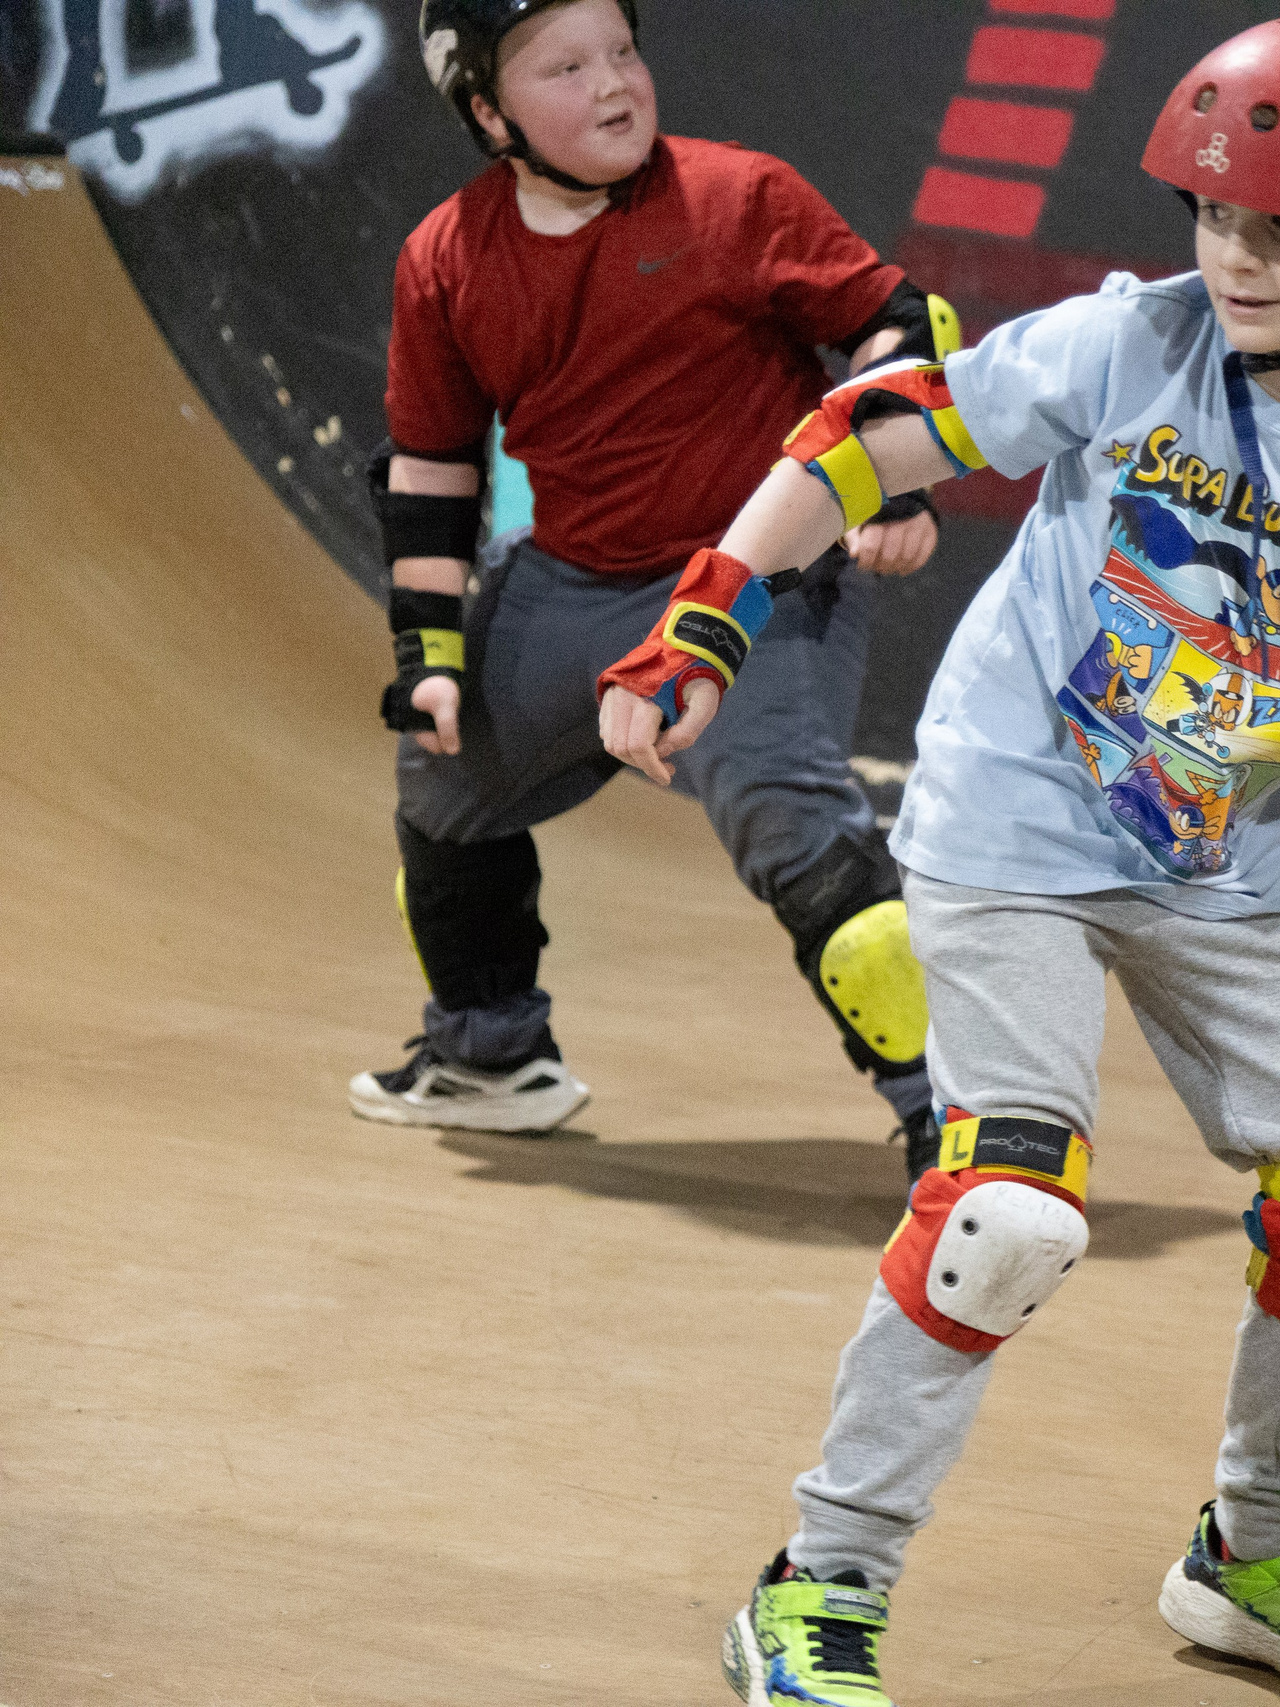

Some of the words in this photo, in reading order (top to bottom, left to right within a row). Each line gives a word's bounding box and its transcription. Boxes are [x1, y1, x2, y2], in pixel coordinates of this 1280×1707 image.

[950, 1130, 969, 1162] L
[978, 1138, 1008, 1147] PRO
[1025, 1141, 1061, 1156] TEC
